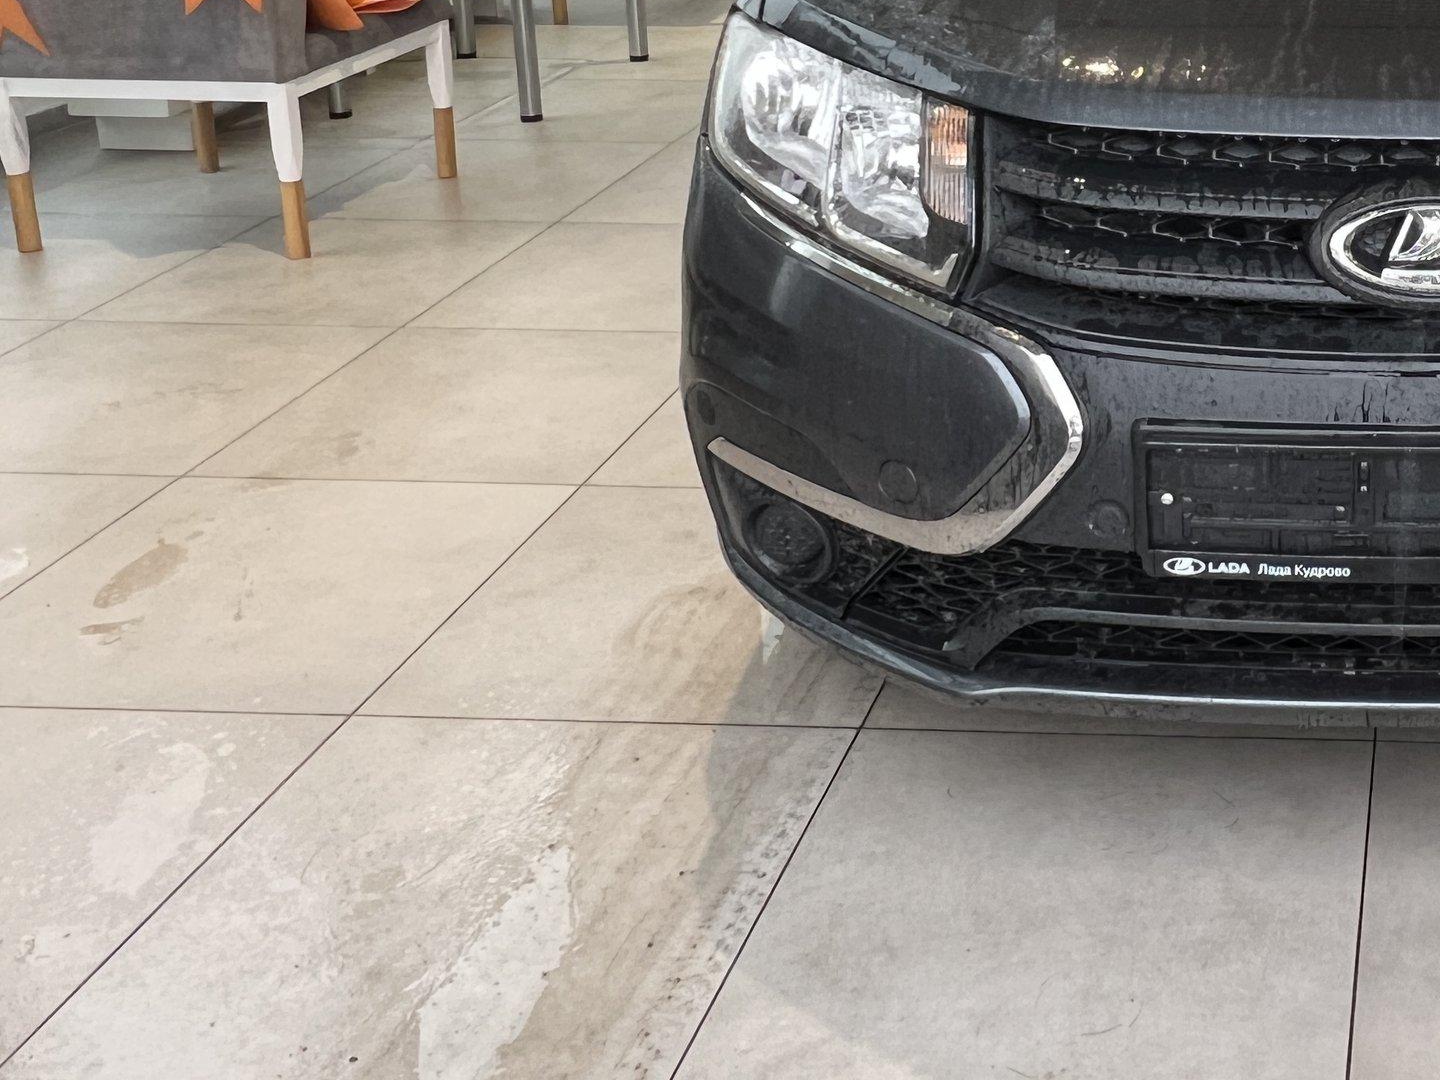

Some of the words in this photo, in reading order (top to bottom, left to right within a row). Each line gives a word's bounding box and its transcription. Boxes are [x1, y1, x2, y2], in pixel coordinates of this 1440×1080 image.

[1208, 561, 1250, 575] LADA
[1257, 563, 1292, 576] Лада
[1294, 564, 1351, 579] Кудрово
